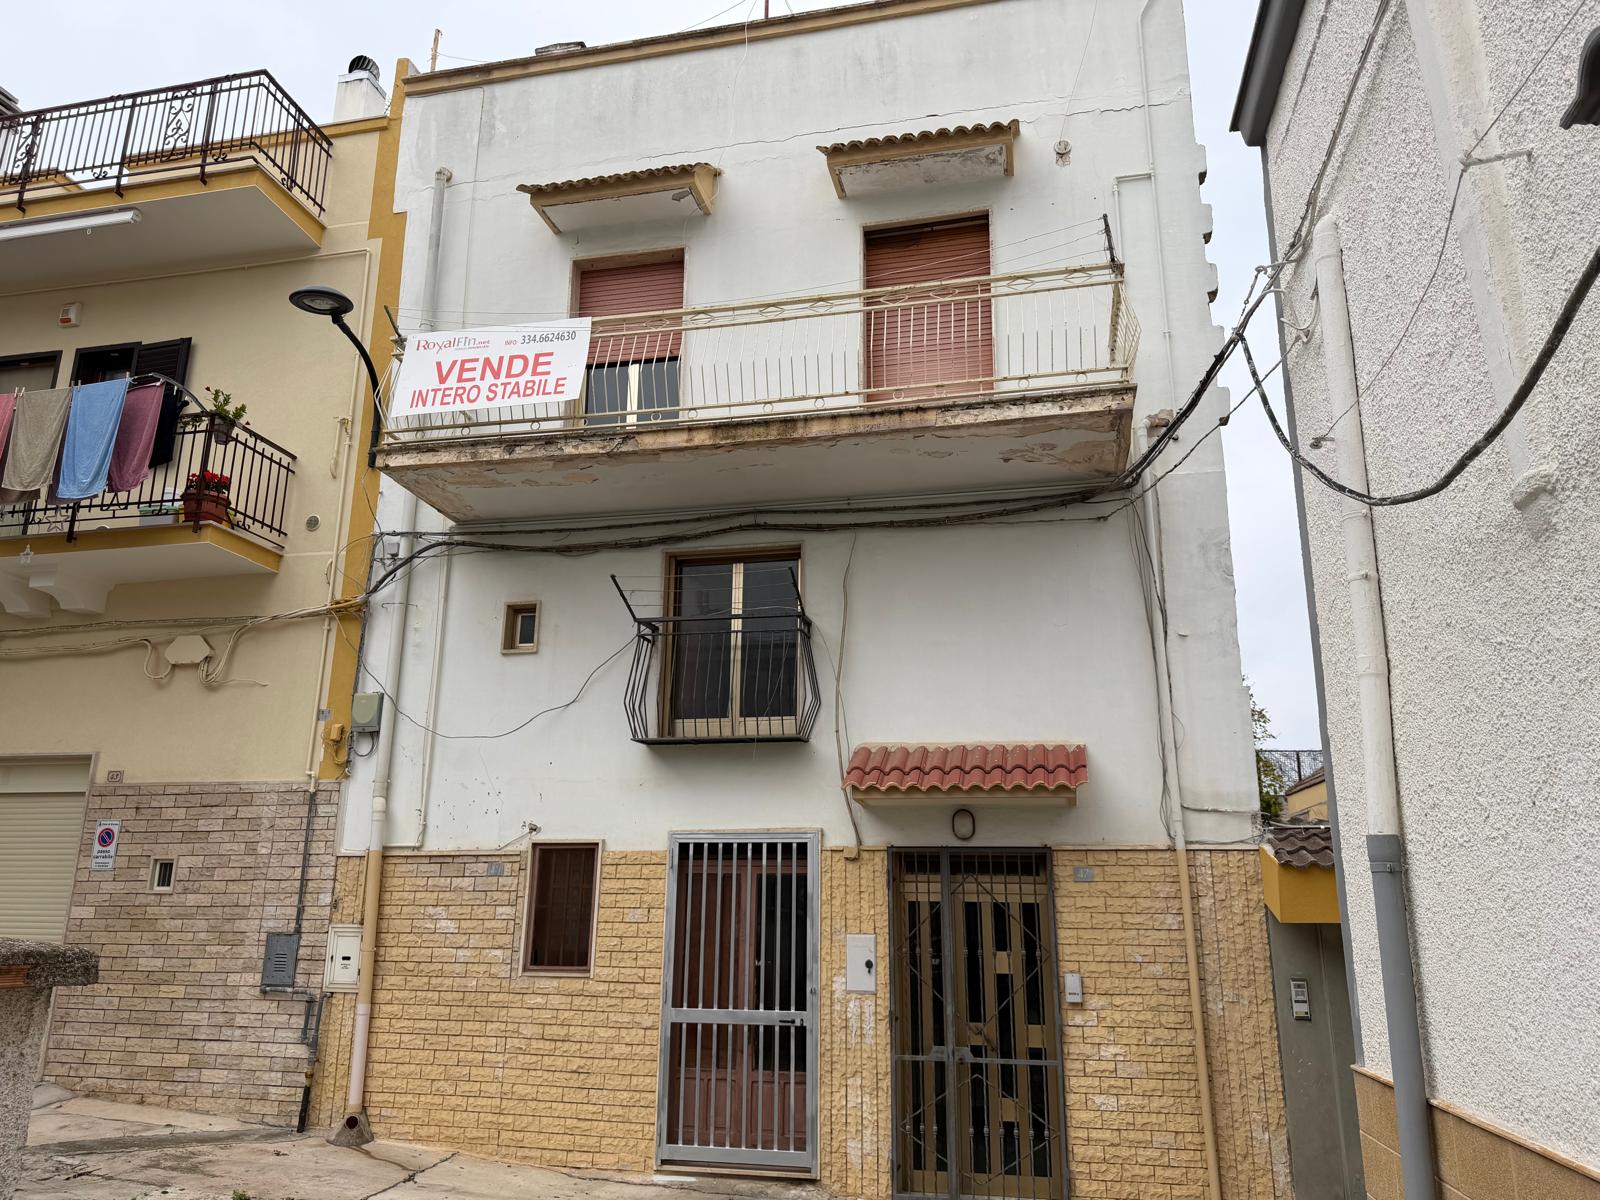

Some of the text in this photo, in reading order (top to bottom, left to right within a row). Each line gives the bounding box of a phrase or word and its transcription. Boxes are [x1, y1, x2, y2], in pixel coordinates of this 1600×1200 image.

[520, 330, 577, 345] 334.6624630
[435, 351, 554, 385] VENDE
[410, 377, 567, 409] INTERO STABILE
